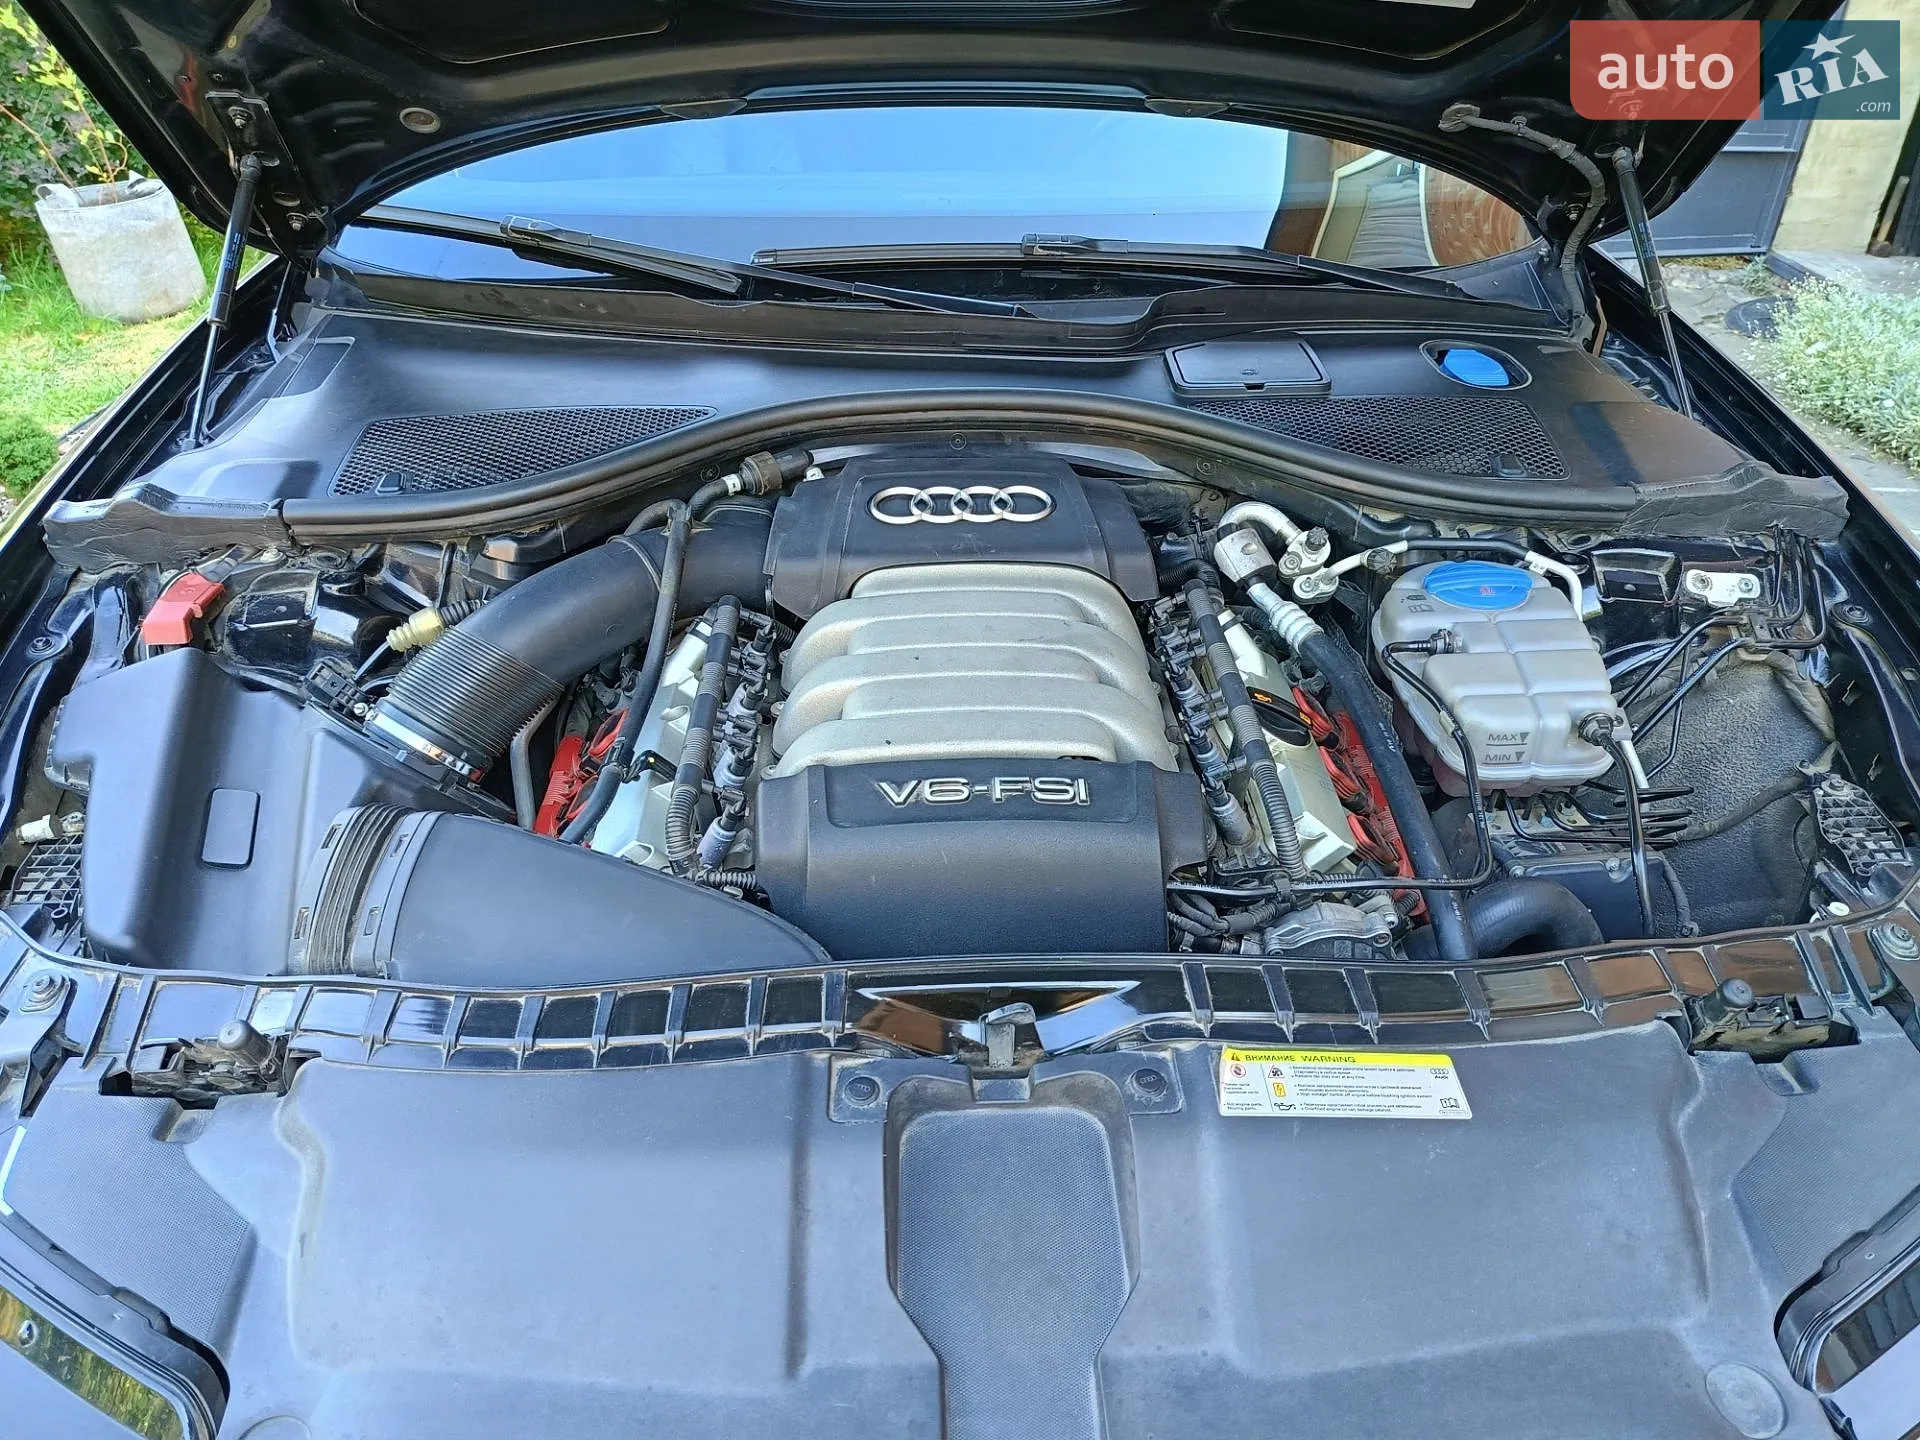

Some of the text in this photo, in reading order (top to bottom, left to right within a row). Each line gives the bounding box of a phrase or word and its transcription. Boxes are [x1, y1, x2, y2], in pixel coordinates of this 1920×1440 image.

[1488, 733, 1518, 742] MAX
[1484, 753, 1512, 762] MIN
[876, 777, 1090, 808] V6-FSI
[1244, 1054, 1357, 1063] ВНИМАНИЕ WARNING
